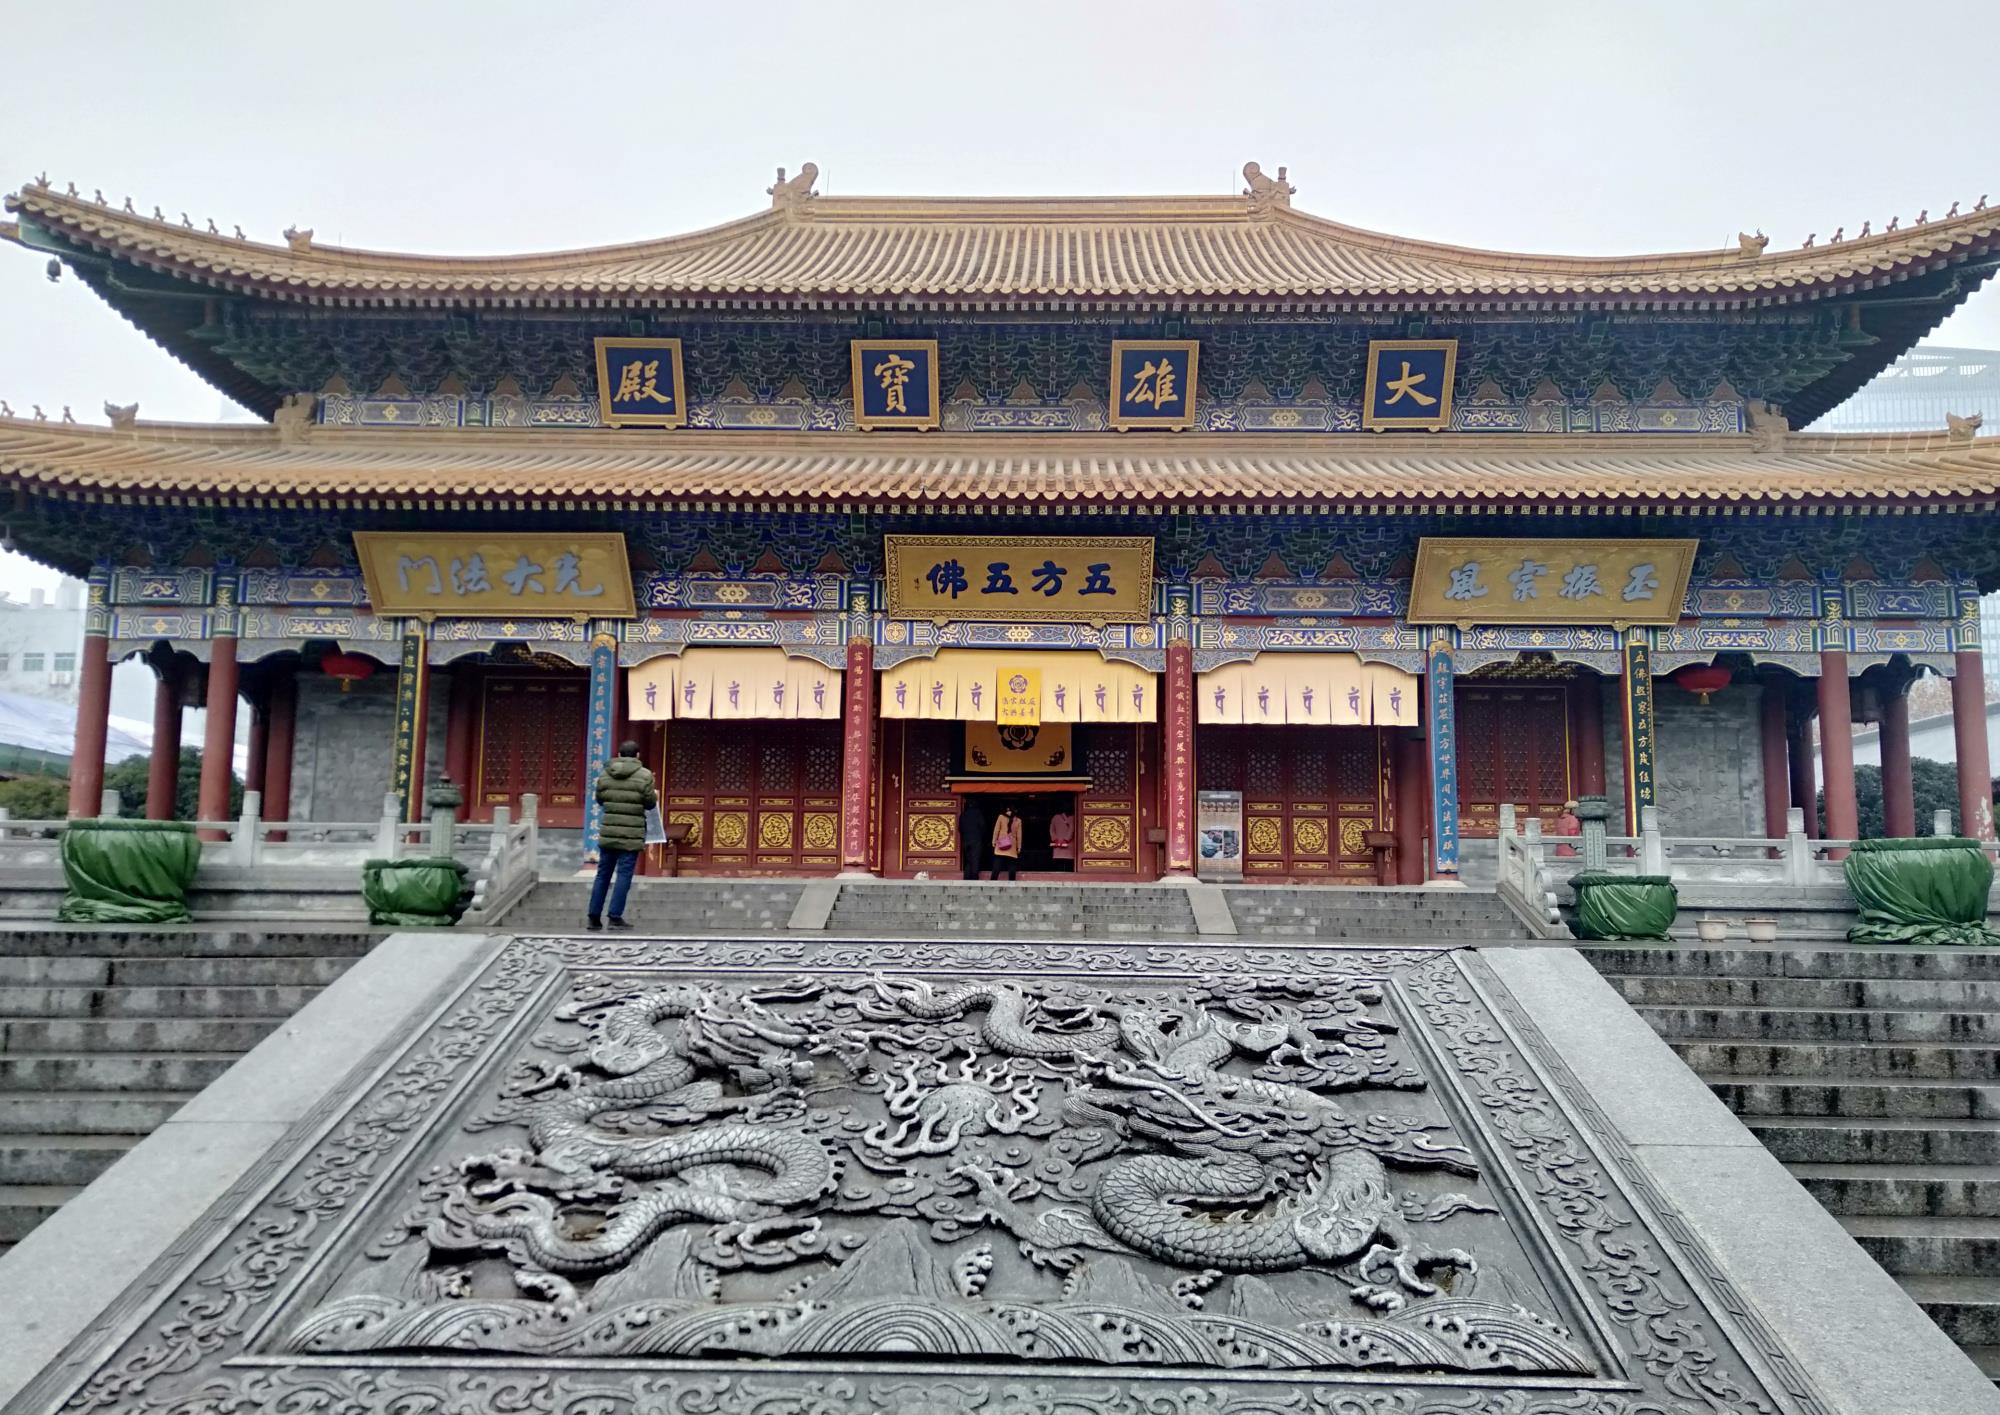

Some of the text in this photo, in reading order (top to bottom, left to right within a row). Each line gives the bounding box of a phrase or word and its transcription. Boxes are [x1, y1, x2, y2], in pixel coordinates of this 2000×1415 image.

[613, 359, 672, 404] 殿
[874, 355, 915, 413] 寶
[1125, 358, 1179, 410] 雄
[1384, 361, 1437, 406] 大
[926, 559, 1117, 599] 五方五佛
